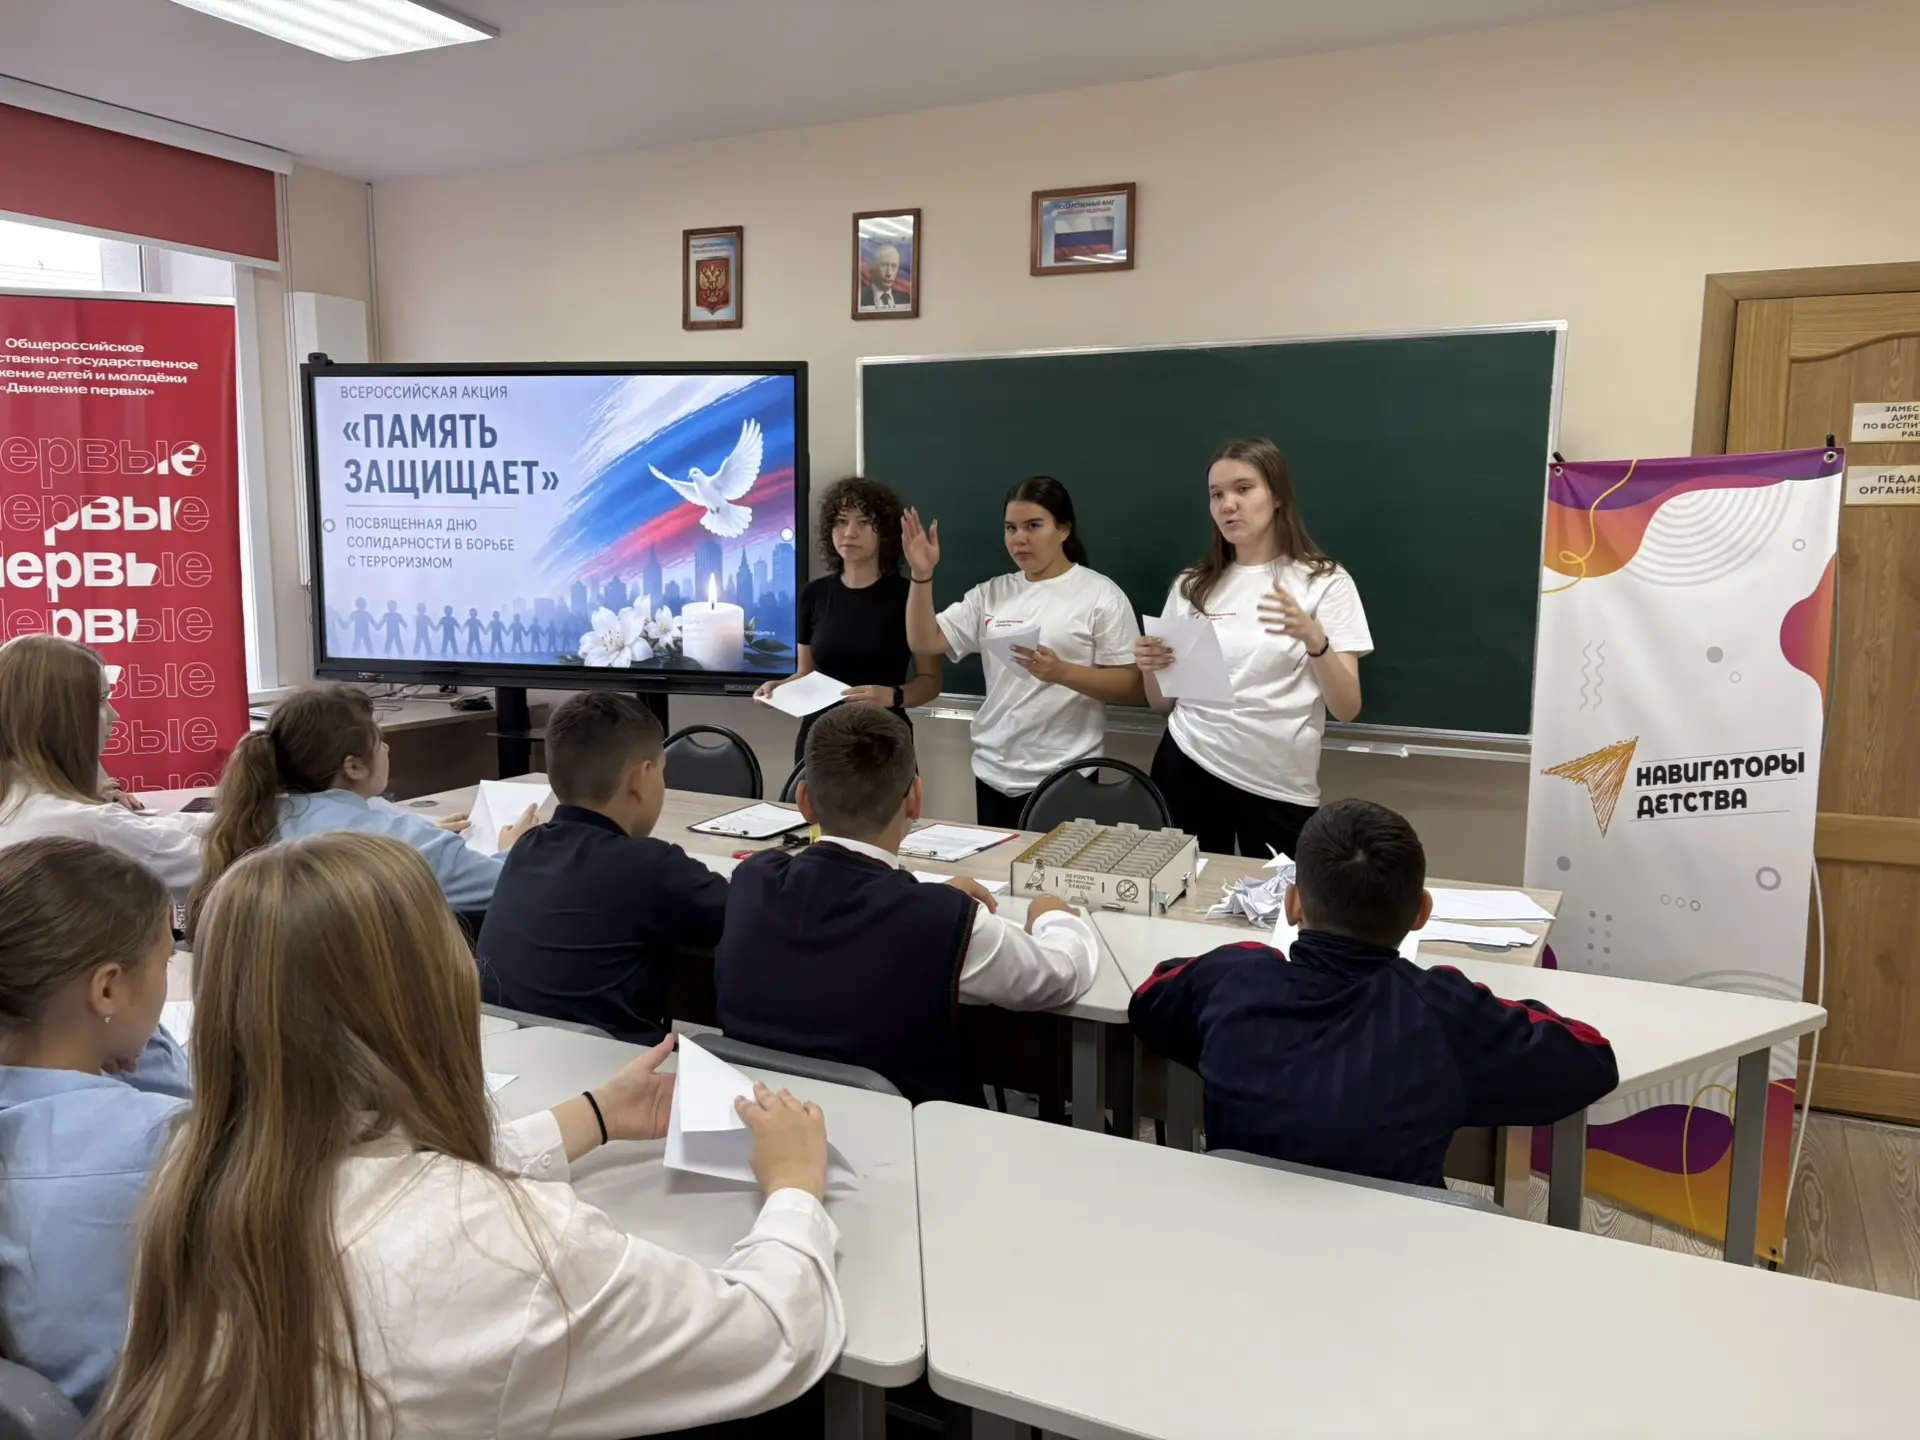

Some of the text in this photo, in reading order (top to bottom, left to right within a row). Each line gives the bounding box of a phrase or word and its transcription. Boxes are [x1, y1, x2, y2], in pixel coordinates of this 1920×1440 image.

[5, 338, 145, 353] Общероссийское
[47, 370, 93, 382] детей
[95, 372, 105, 381] и
[108, 371, 188, 384] молодёжи
[0, 382, 155, 397] «Движение первых»
[340, 383, 508, 401] ВСЕРОССИЙСКАЯ АКЦИЯ
[1885, 405, 1920, 413] ЗАМЕС
[1891, 413, 1920, 422] ДИРЕ
[342, 413, 498, 449] «ПАМЯТЬ
[1880, 422, 1920, 430] ВОСПИ
[344, 458, 560, 500] ЗАЩИЩАЕТ»
[0, 493, 210, 547] ервые
[346, 516, 477, 532] ПОСВЯЩЕННАЯ ДНЮ
[346, 535, 515, 552] СОЛИДАРНОСТИ В БОРЬБЕ
[347, 555, 453, 569] С ТЕРРОРИЗМОМ
[0, 541, 213, 602] ервые
[0, 598, 213, 643] ервые
[1636, 752, 1805, 787] НАВИГАТОРЫ
[1636, 788, 1748, 819] ДЕТСТВА
